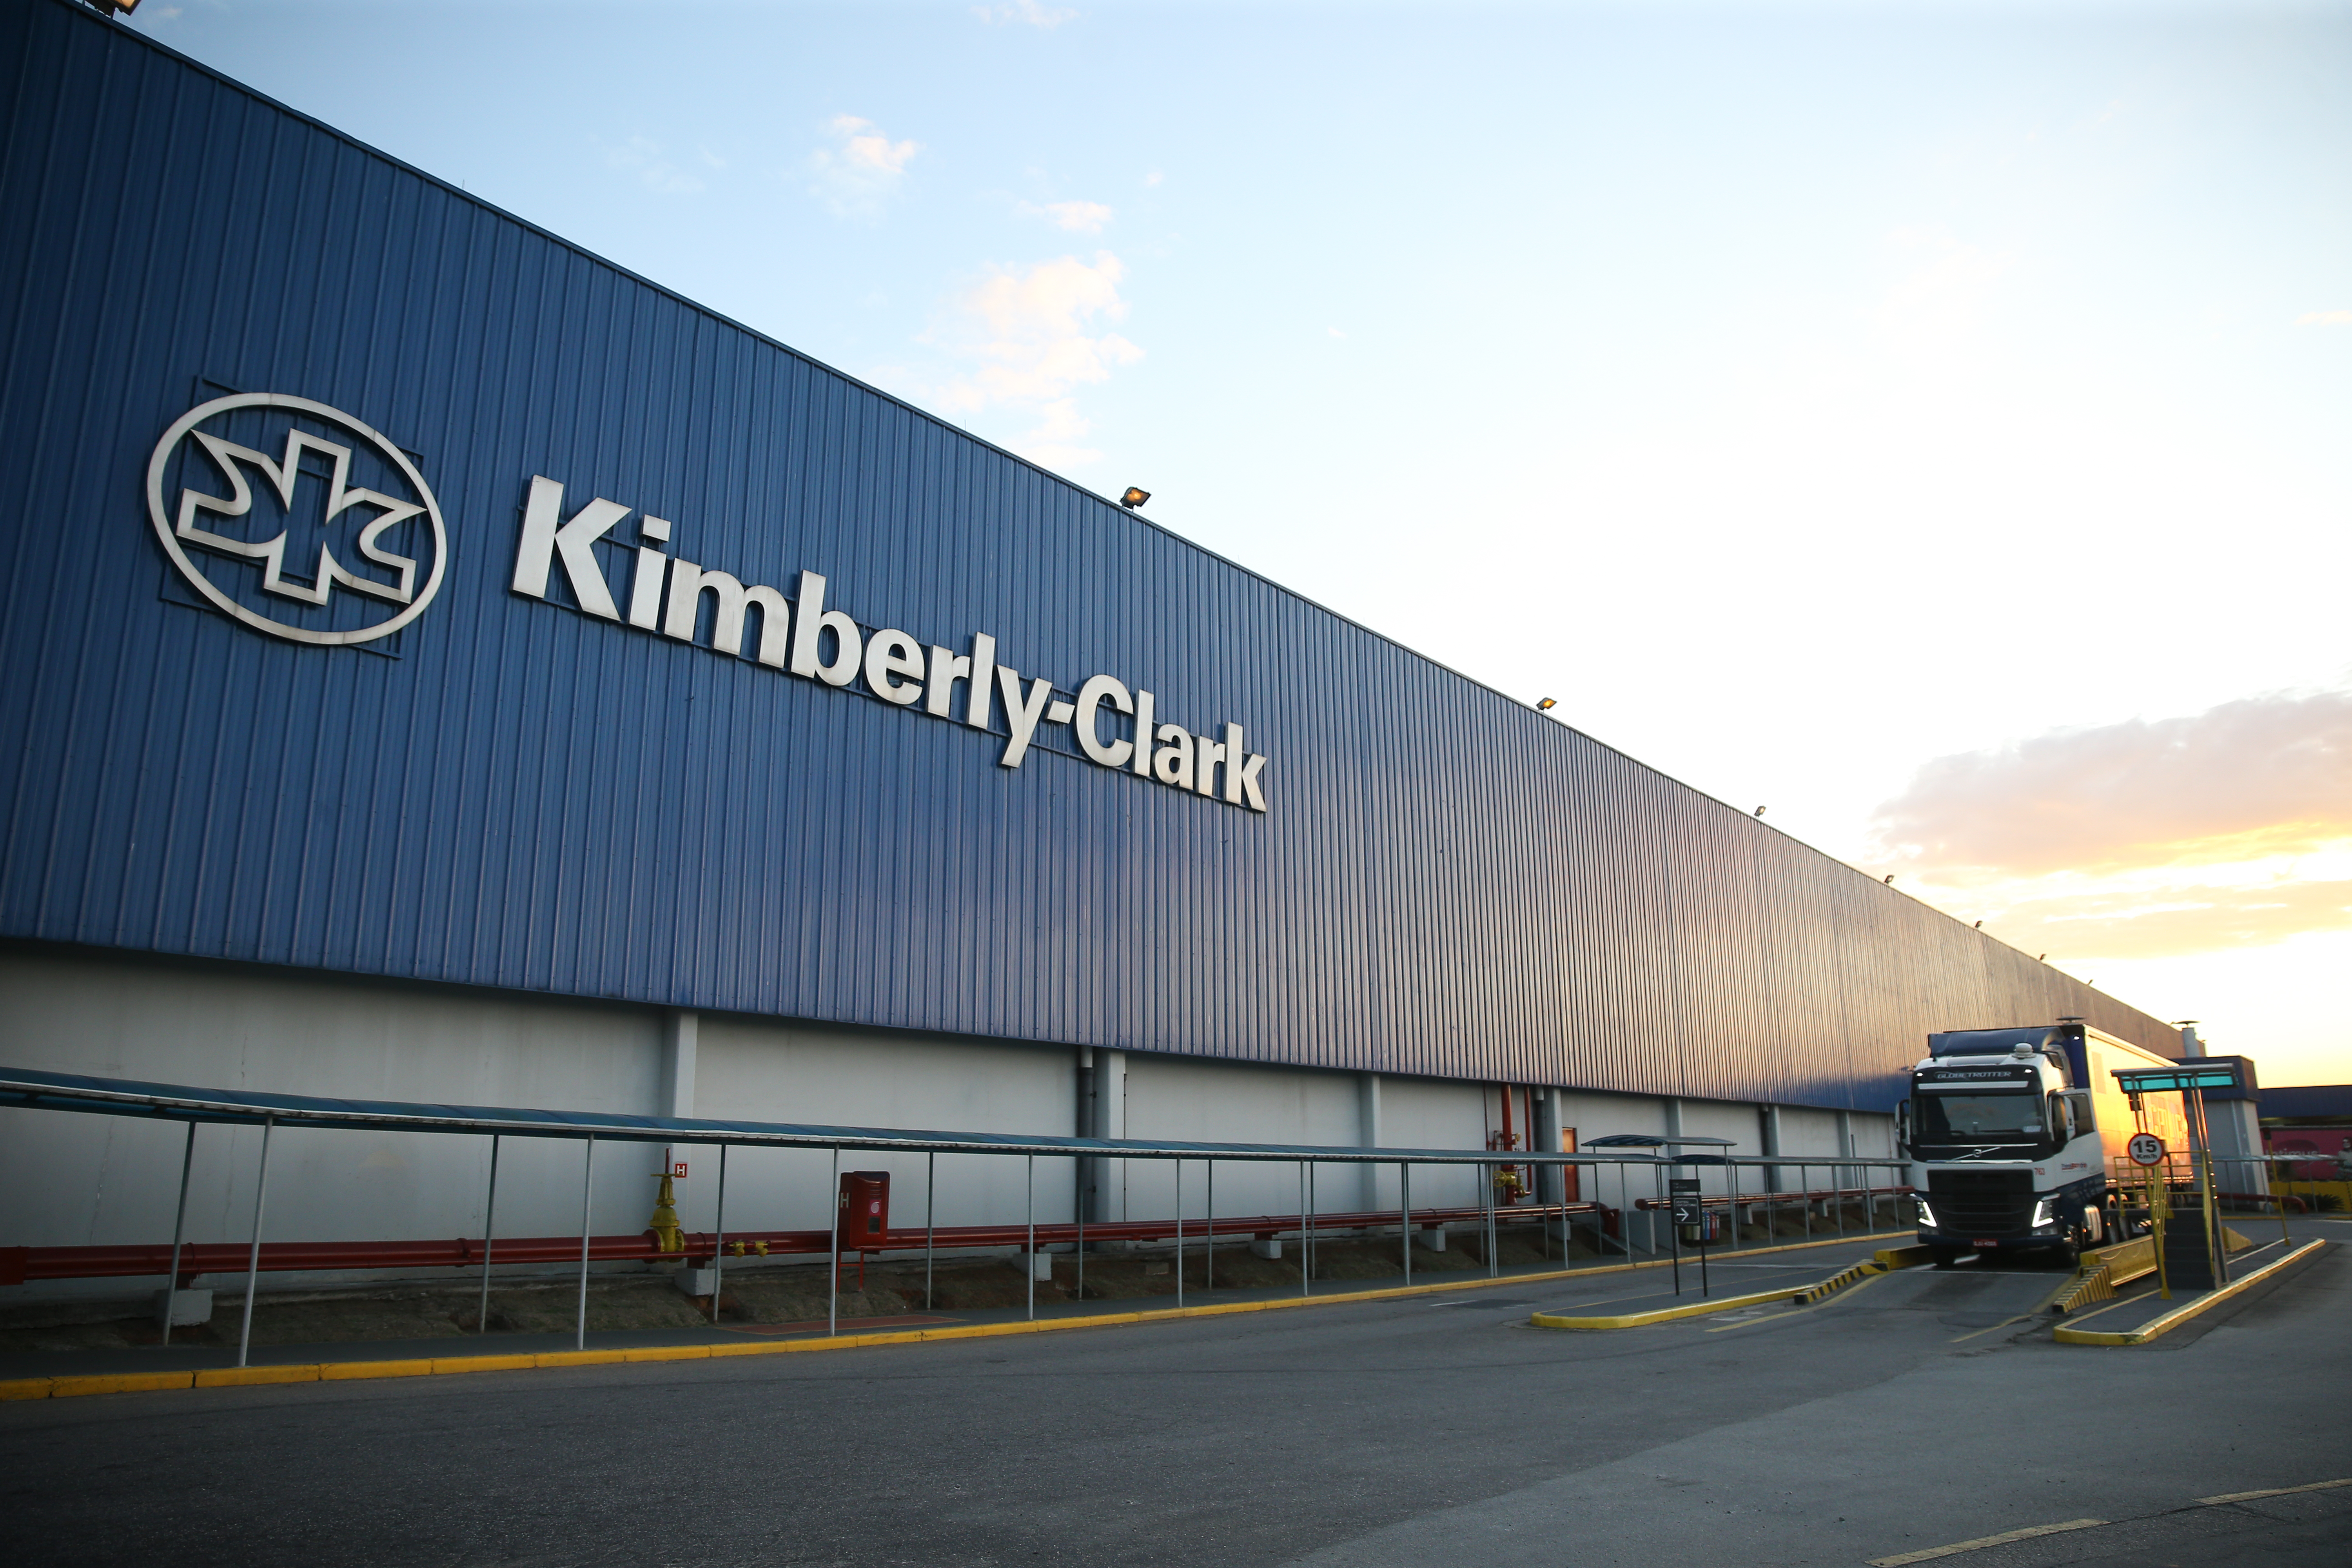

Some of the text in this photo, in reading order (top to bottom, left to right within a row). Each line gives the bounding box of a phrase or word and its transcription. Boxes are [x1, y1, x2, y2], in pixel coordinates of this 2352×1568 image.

[512, 474, 1267, 812] Kimberly-Clark
[2134, 1140, 2157, 1153] 15
[677, 1165, 685, 1176] H
[840, 1192, 849, 1208] H
